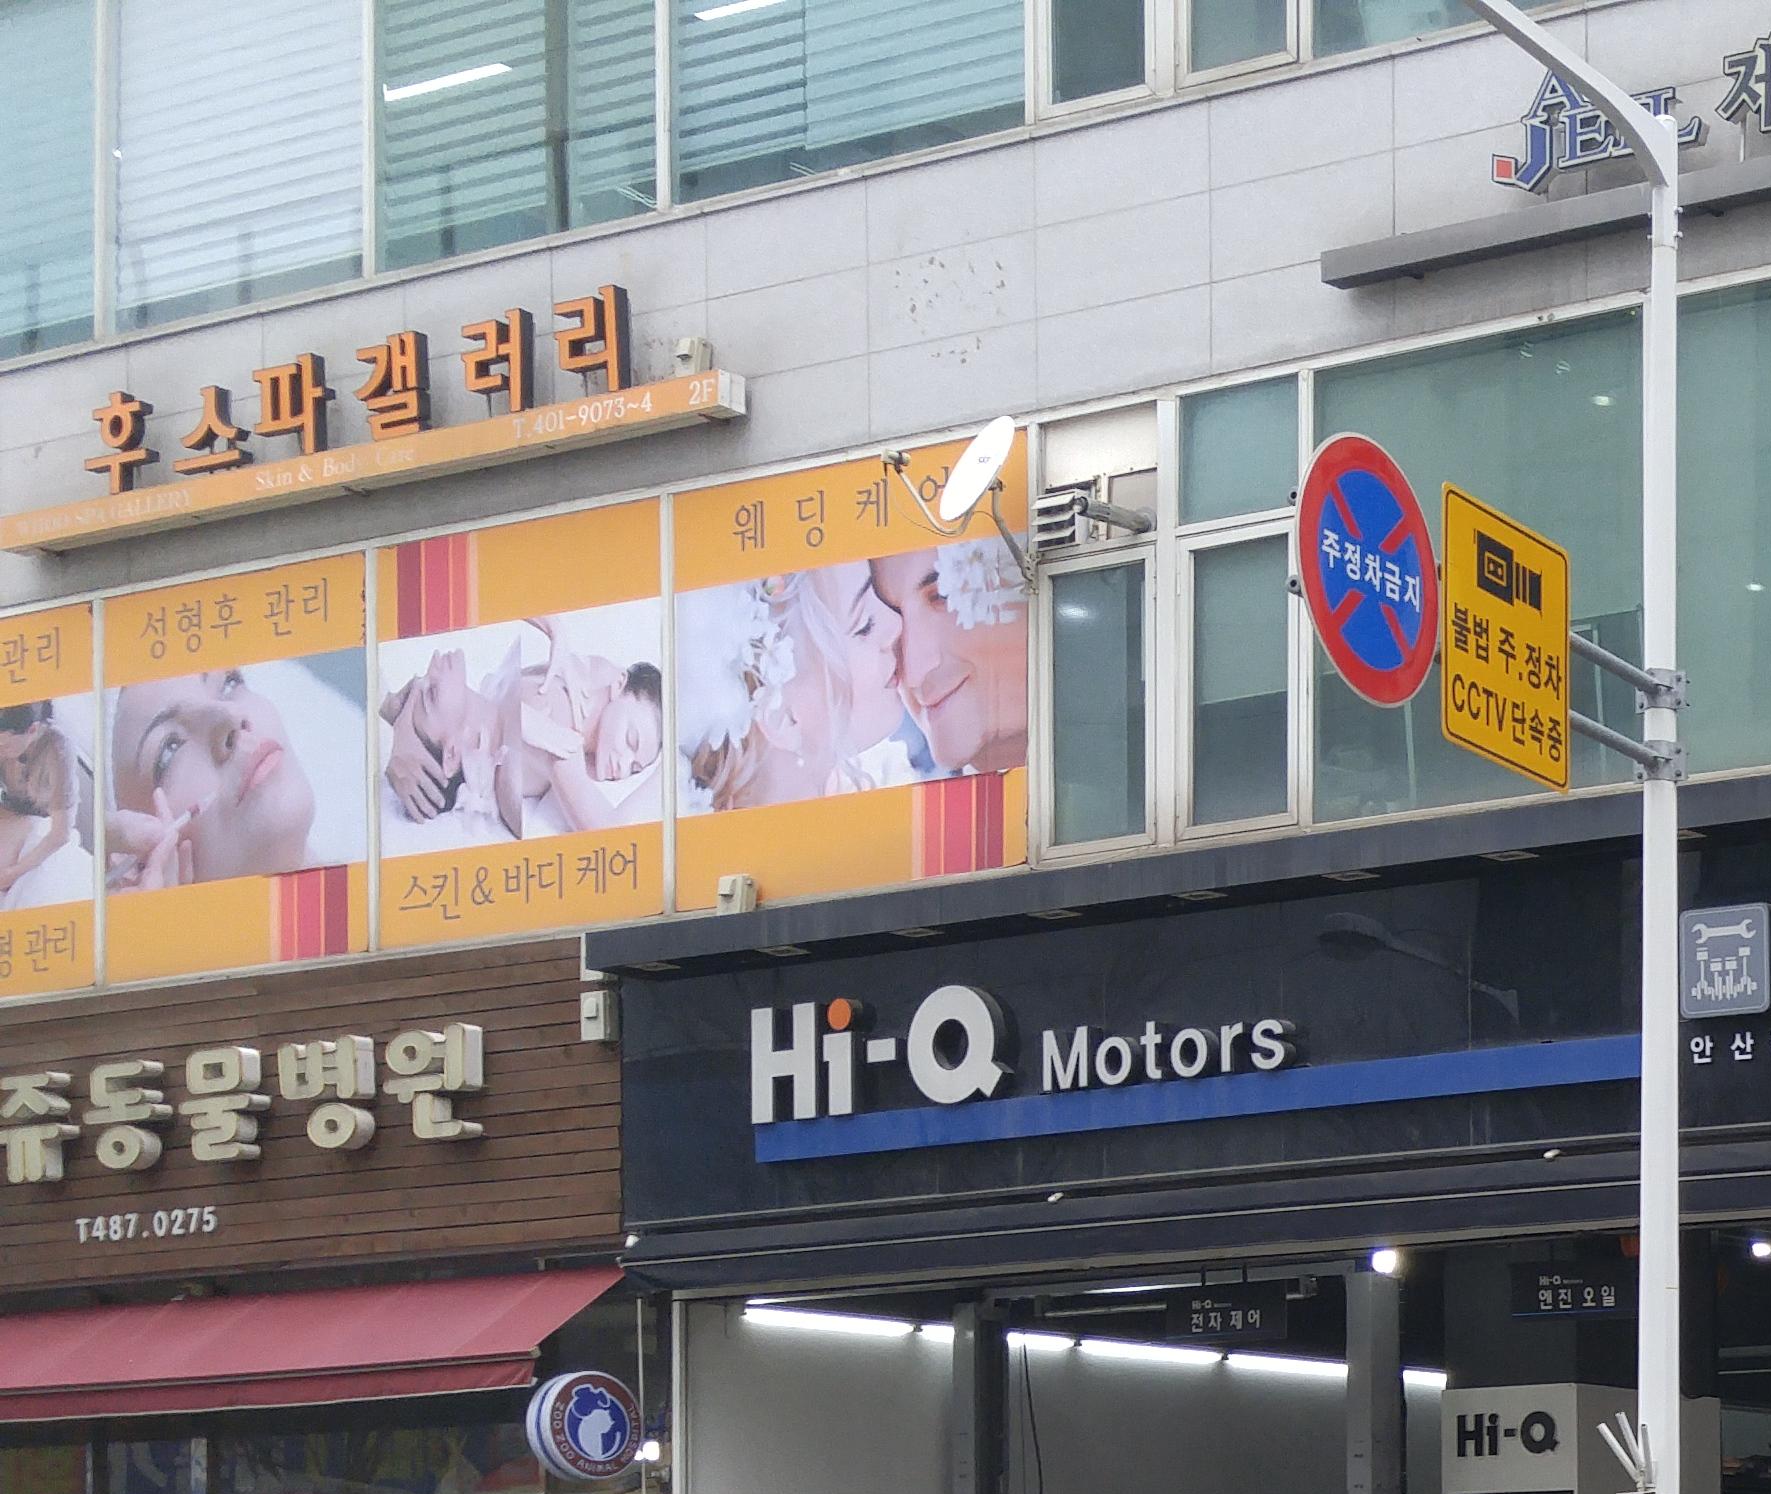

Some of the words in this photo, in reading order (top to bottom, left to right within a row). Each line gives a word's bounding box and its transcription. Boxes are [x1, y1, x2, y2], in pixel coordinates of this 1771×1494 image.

[84, 284, 634, 495] 후스파갤러리
[513, 394, 654, 440] T.401-9073~4
[688, 378, 717, 407] 2F
[322, 452, 366, 478] Bod
[1322, 528, 1422, 613] 주정차금지
[141, 592, 243, 662] 성형후
[264, 577, 329, 637] 관리
[1450, 602, 1490, 664] 불법
[398, 868, 461, 928] 스킨
[502, 853, 566, 905] 바디
[576, 843, 640, 893] 케어
[25, 925, 76, 974] 관리
[751, 985, 1003, 1124] Hi-Q
[1041, 1017, 1289, 1092] Motors
[75, 1206, 218, 1244] T487.0275
[1191, 1311, 1222, 1333] 전자
[1229, 1309, 1260, 1331] 제어
[1538, 1289, 1573, 1310] 엔진
[1582, 1285, 1616, 1307] 오일
[1456, 1410, 1561, 1458] Hi-Q
